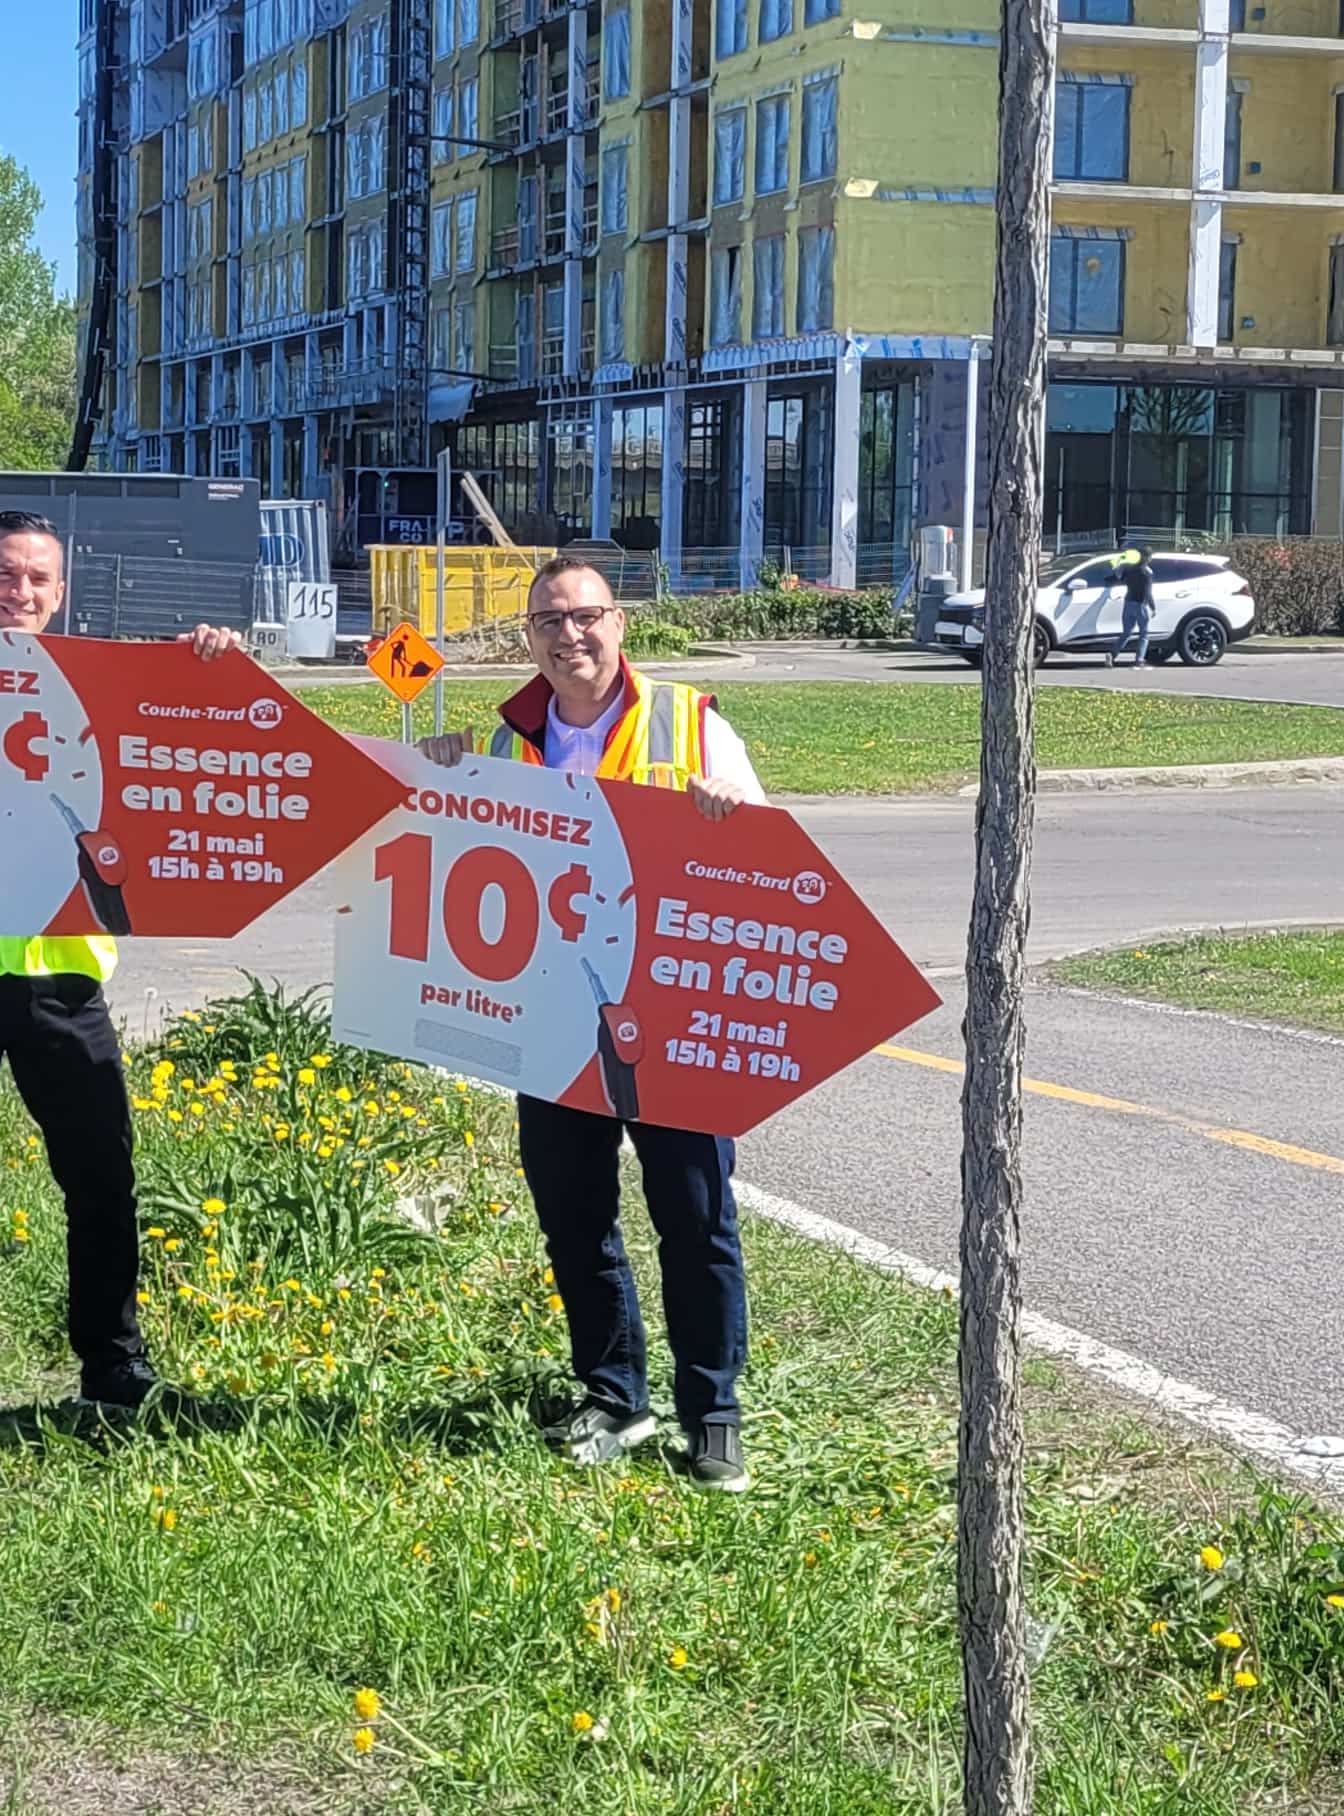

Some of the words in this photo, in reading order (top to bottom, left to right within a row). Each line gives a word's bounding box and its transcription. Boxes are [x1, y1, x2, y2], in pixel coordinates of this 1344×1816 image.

[293, 585, 334, 620] 115
[138, 702, 246, 721] Couche-Tard
[118, 734, 313, 778] Essence
[121, 783, 183, 812] en
[192, 781, 310, 820] folie
[401, 786, 592, 847] CONOMISEZ
[167, 828, 200, 852] 21
[206, 833, 265, 855] mai
[148, 855, 200, 879] 15h
[205, 857, 225, 880] à
[230, 860, 284, 884] 19h
[684, 860, 792, 892] Couche-Tard
[374, 831, 593, 983] 10¢
[654, 896, 849, 964] Essence
[419, 982, 461, 1005] par
[649, 955, 712, 991] en
[722, 956, 839, 1011] folie
[687, 1010, 723, 1038] 21
[726, 1020, 788, 1048] mai
[665, 1038, 717, 1068] 15h
[721, 1046, 742, 1073] à
[747, 1051, 801, 1083] 19h
